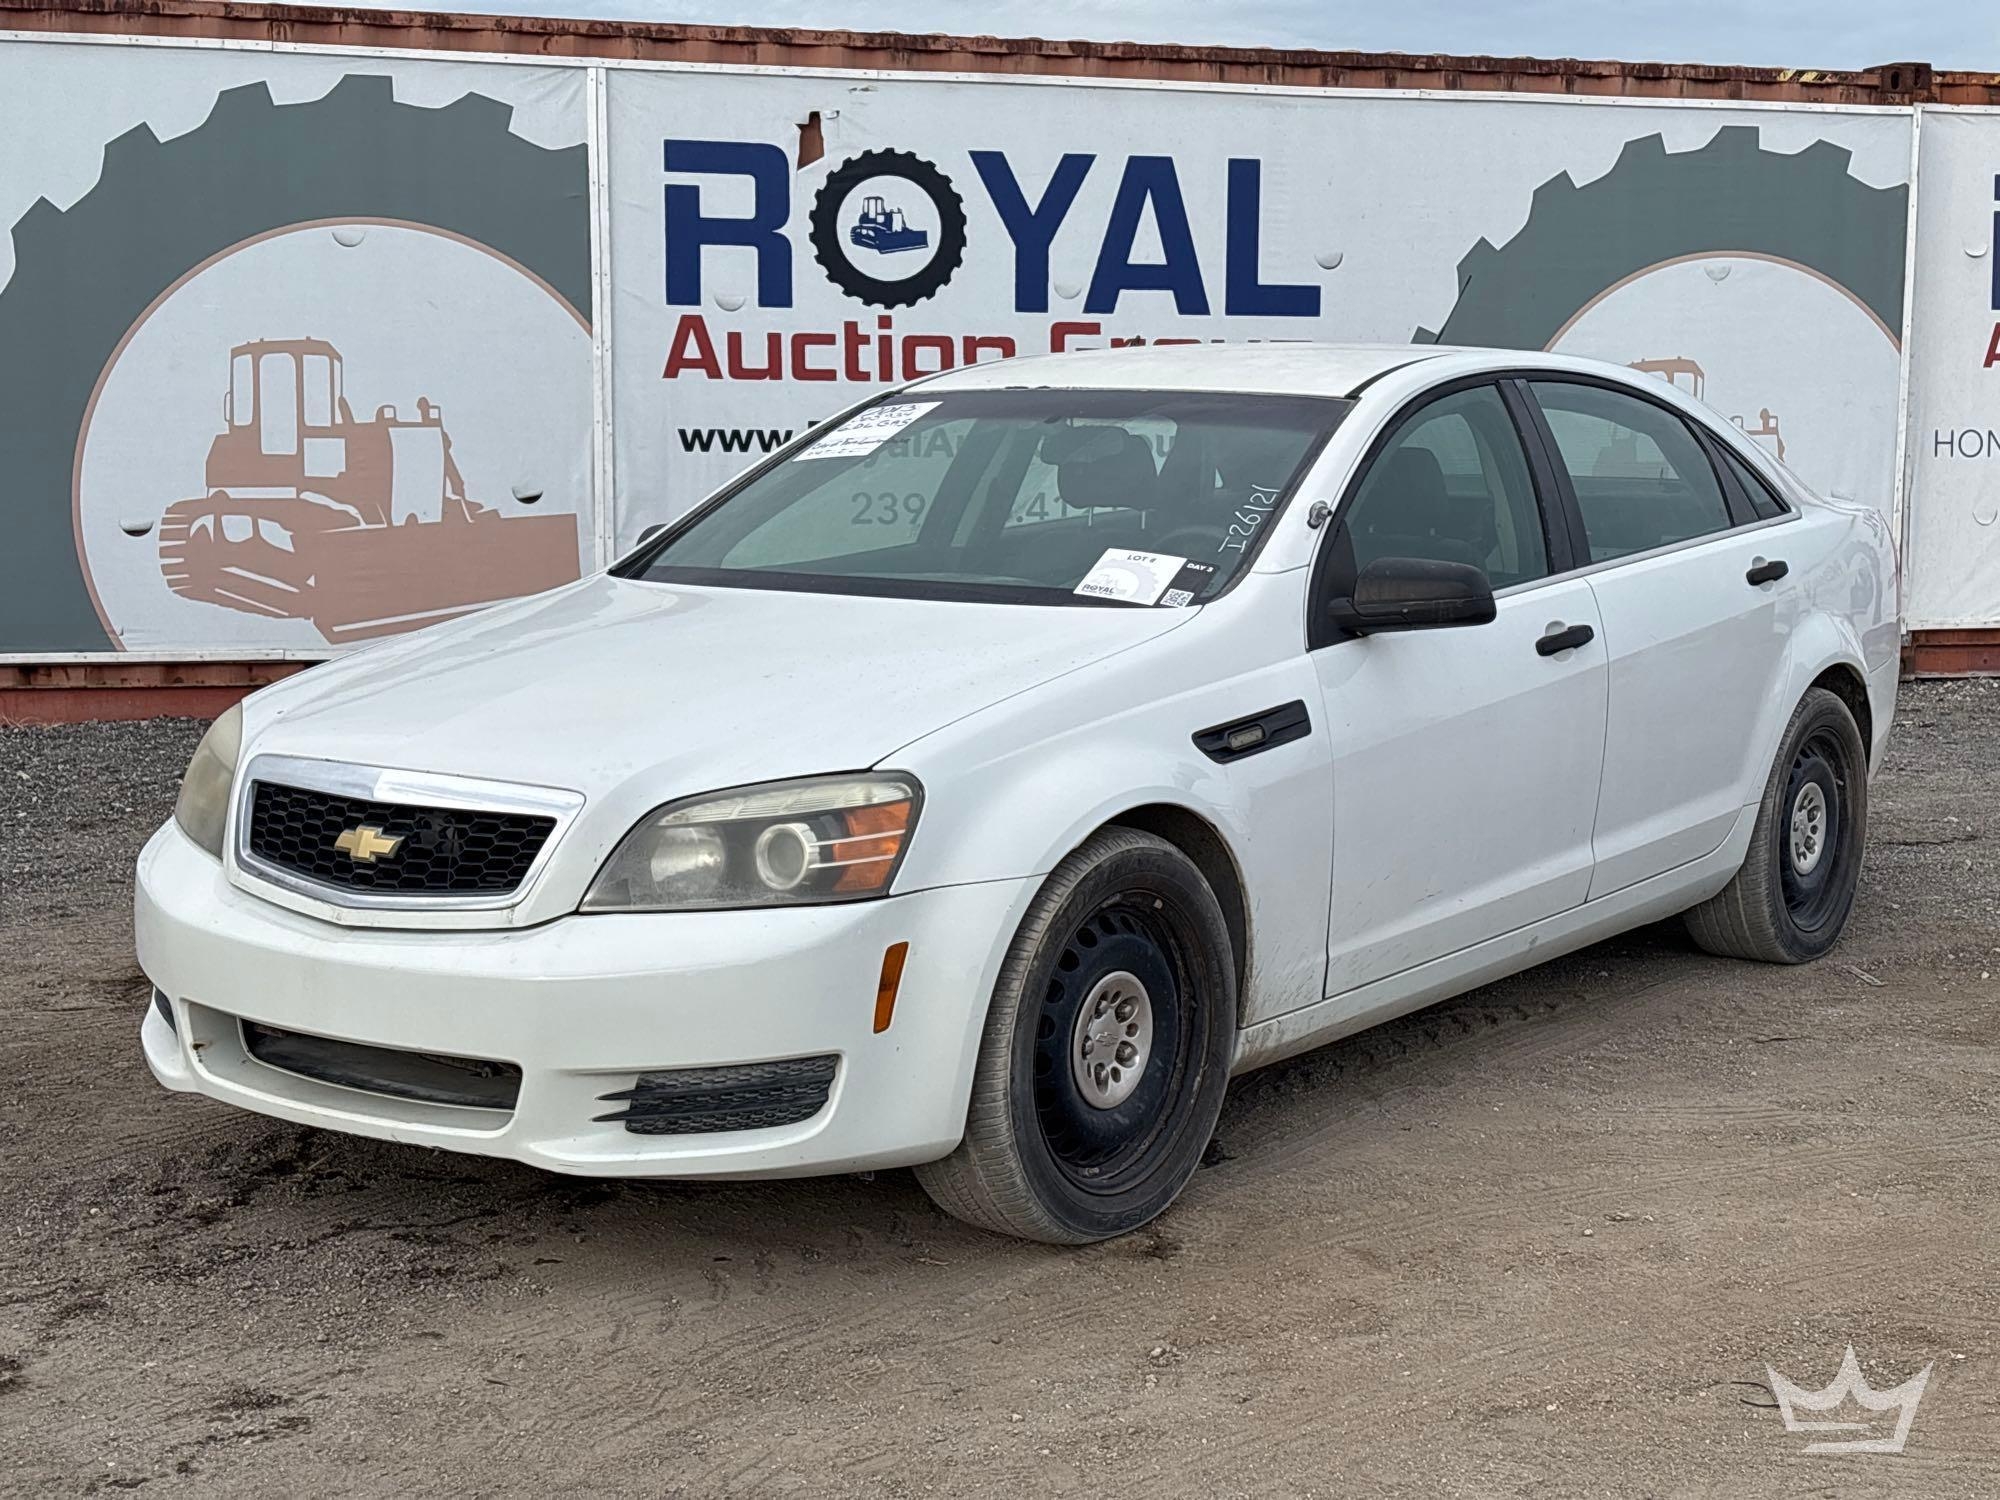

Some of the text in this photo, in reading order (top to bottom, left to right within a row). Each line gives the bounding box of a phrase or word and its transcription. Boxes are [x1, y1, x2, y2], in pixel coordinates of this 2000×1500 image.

[663, 139, 1321, 317] ROYAL
[662, 315, 1016, 382] Auction
[1126, 554, 1148, 563] LOT
[1186, 562, 1207, 571] DAY
